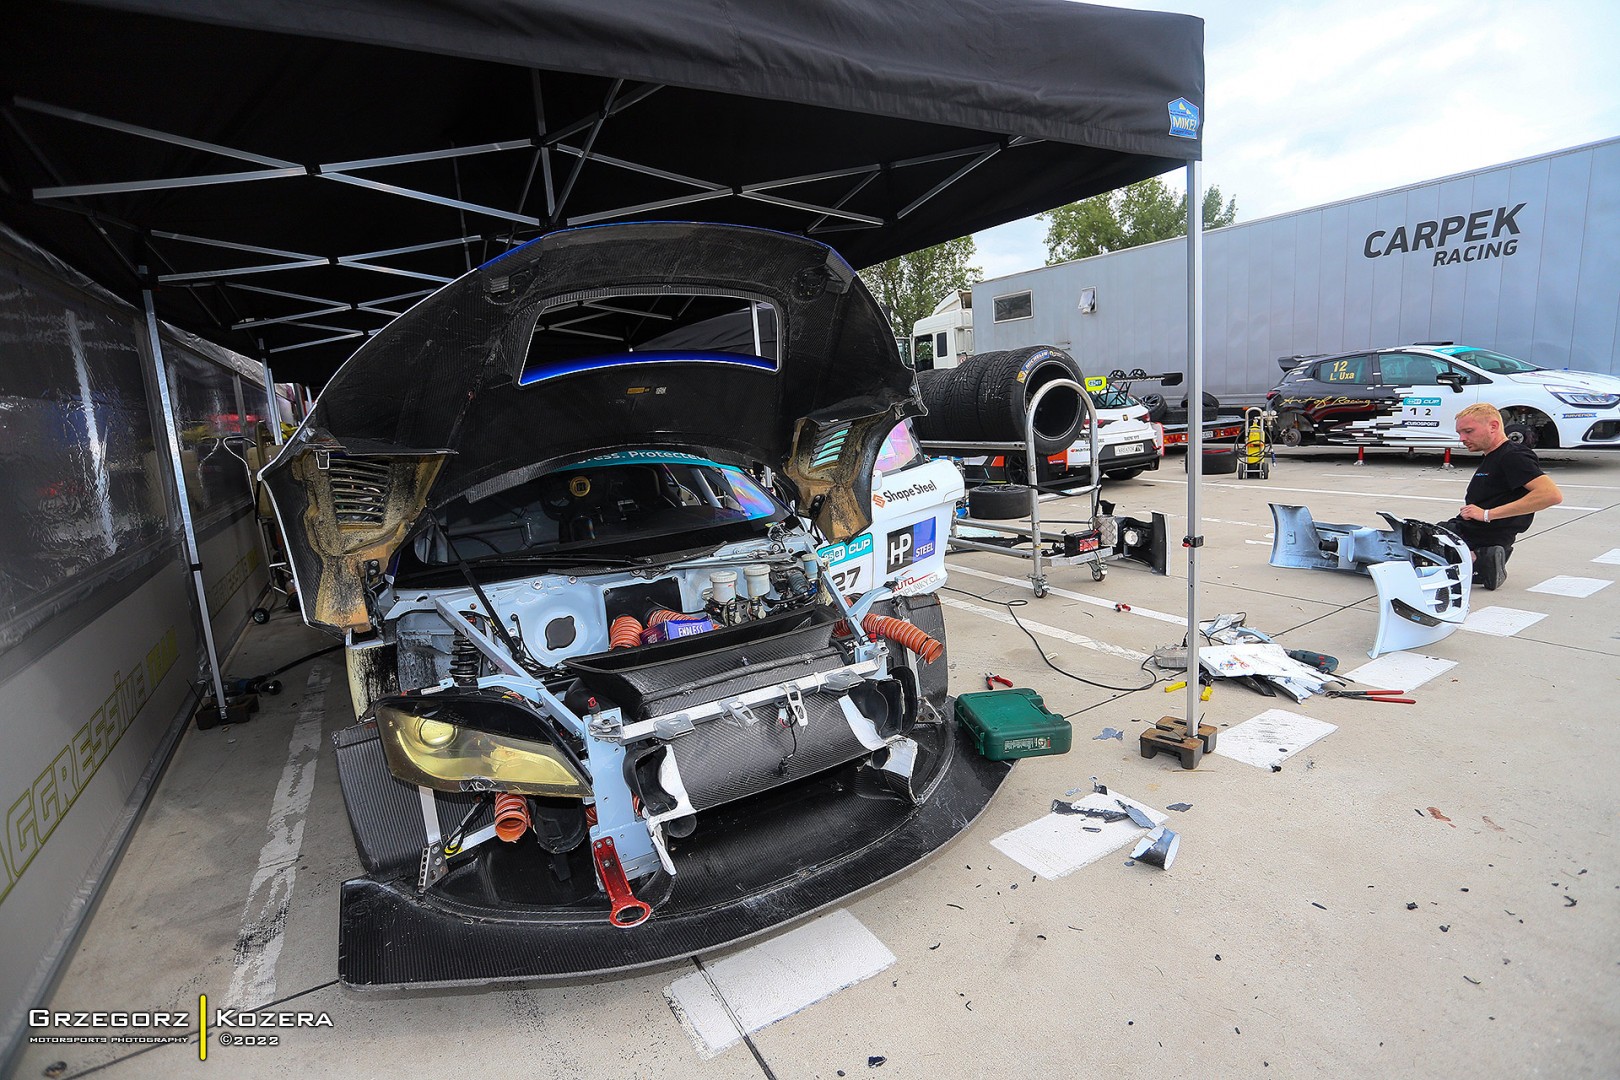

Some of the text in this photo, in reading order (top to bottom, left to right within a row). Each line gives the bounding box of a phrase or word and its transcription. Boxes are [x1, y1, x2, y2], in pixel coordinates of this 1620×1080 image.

[1363, 202, 1527, 259] CARPEK
[1432, 239, 1518, 267] RACING
[1333, 361, 1348, 373] 12
[1330, 371, 1355, 381] L. Uxa
[1314, 396, 1333, 409] of
[1332, 397, 1371, 408] Racing
[1410, 407, 1432, 416] 1 2
[883, 480, 937, 504] Shape Steel
[848, 538, 871, 555] CUP
[890, 533, 913, 565] HP
[915, 544, 934, 558] STEEL
[831, 565, 861, 592] 27
[678, 624, 704, 637] ENDLESS
